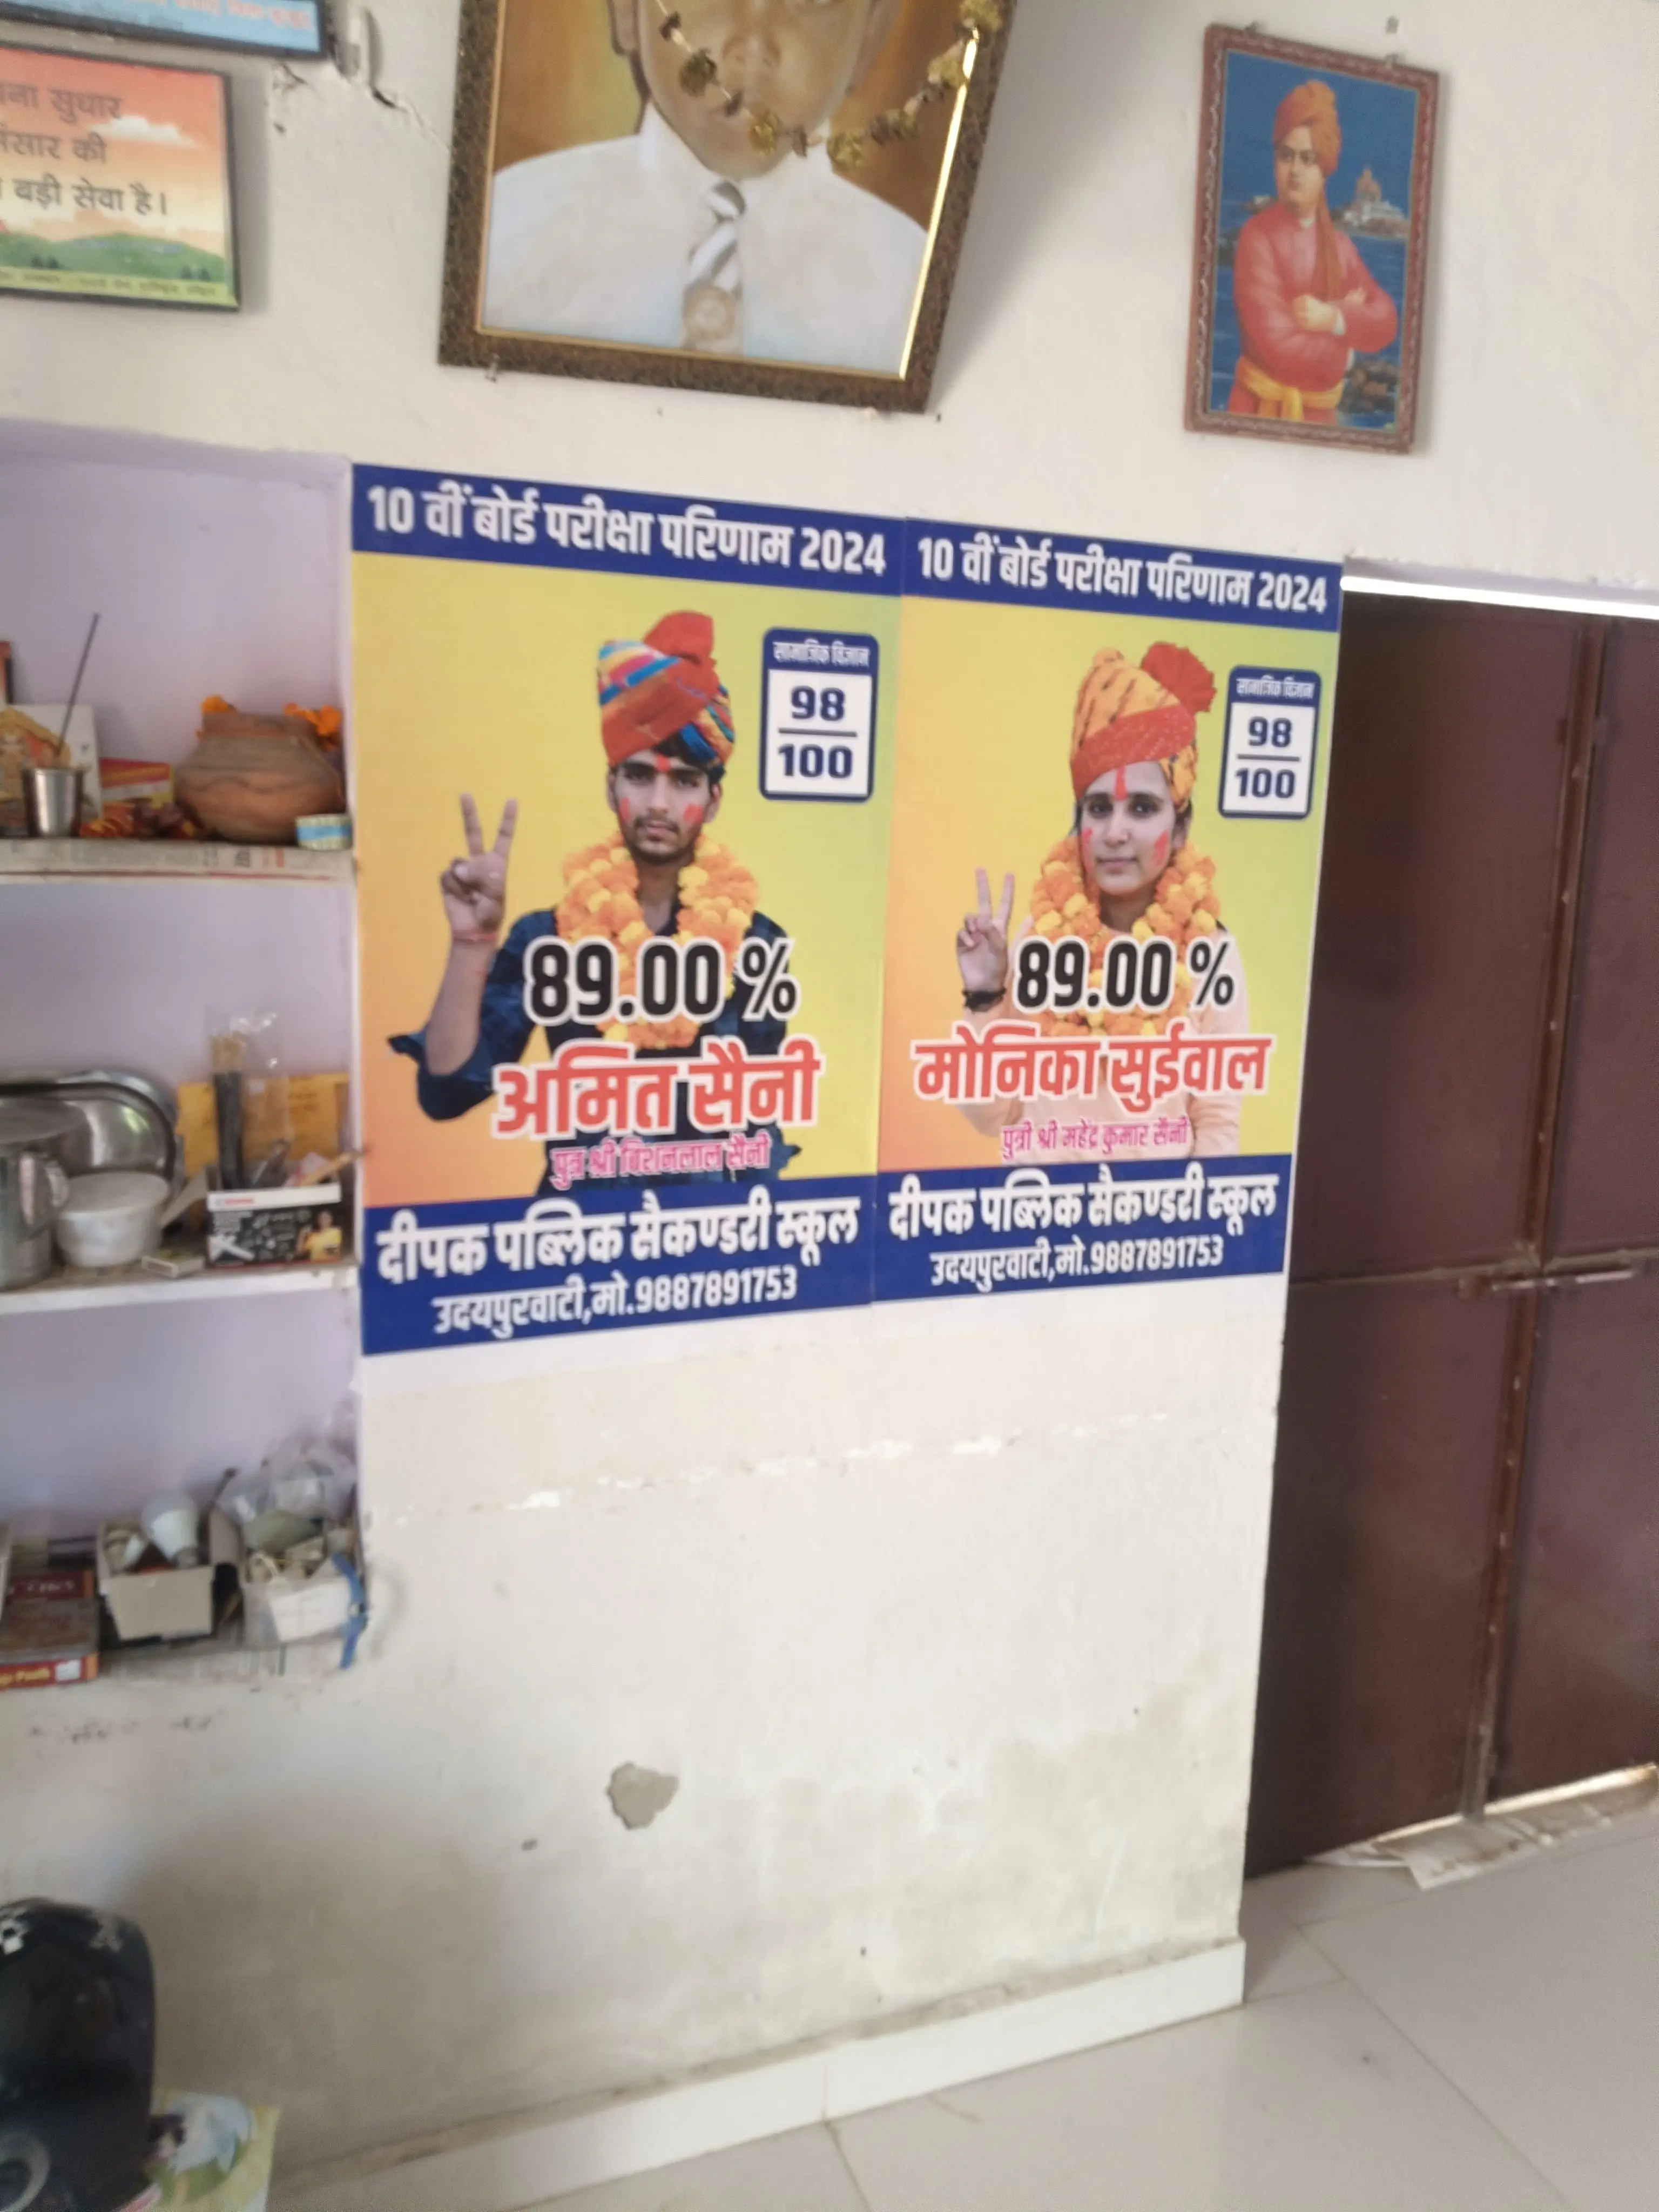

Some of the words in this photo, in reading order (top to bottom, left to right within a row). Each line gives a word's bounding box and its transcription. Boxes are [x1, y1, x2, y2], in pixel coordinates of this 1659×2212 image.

[0, 82, 38, 108] ना
[48, 88, 123, 125] सुधार
[71, 131, 107, 163] की
[71, 177, 125, 212] सेवा
[368, 484, 414, 535] 10
[423, 478, 473, 538] वीं
[471, 483, 538, 545] बोर्ड
[542, 494, 653, 556] परीक्षा
[658, 503, 794, 568] परिणाम
[800, 526, 886, 577] 2024
[918, 536, 954, 581] 10
[961, 531, 998, 585] वीं
[997, 535, 1052, 589] बोर्ड
[1054, 543, 1143, 598] परीक्षा
[1147, 552, 1254, 608] परिणाम
[1257, 571, 1327, 615] 2024
[791, 685, 846, 721] 98
[1249, 716, 1292, 747] 98
[778, 743, 853, 778] 100
[1235, 767, 1296, 798] 100
[527, 939, 723, 1023] 89.00
[1014, 938, 1175, 1011] 89.00
[494, 1041, 680, 1137] अमित
[686, 1036, 824, 1128] सैनी
[913, 1020, 1102, 1100] मोनिका
[1107, 1019, 1274, 1115] सुईवाल
[589, 1136, 617, 1178] श्री
[725, 1130, 772, 1170] सैनी
[1003, 1121, 1032, 1159] पुत्री
[1037, 1119, 1058, 1149] श्री
[1102, 1123, 1149, 1155] कुमार
[1153, 1115, 1190, 1145] सैनी
[888, 1173, 975, 1240] दीपक
[980, 1168, 1084, 1232] पब्लिक
[1088, 1162, 1206, 1227] सैकण्डरी
[1208, 1174, 1280, 1236] स्कूल
[375, 1208, 489, 1285] दीपक
[494, 1197, 625, 1271] पब्लिक
[630, 1185, 771, 1262] सैकण्डरी
[776, 1196, 861, 1266] स्कूल
